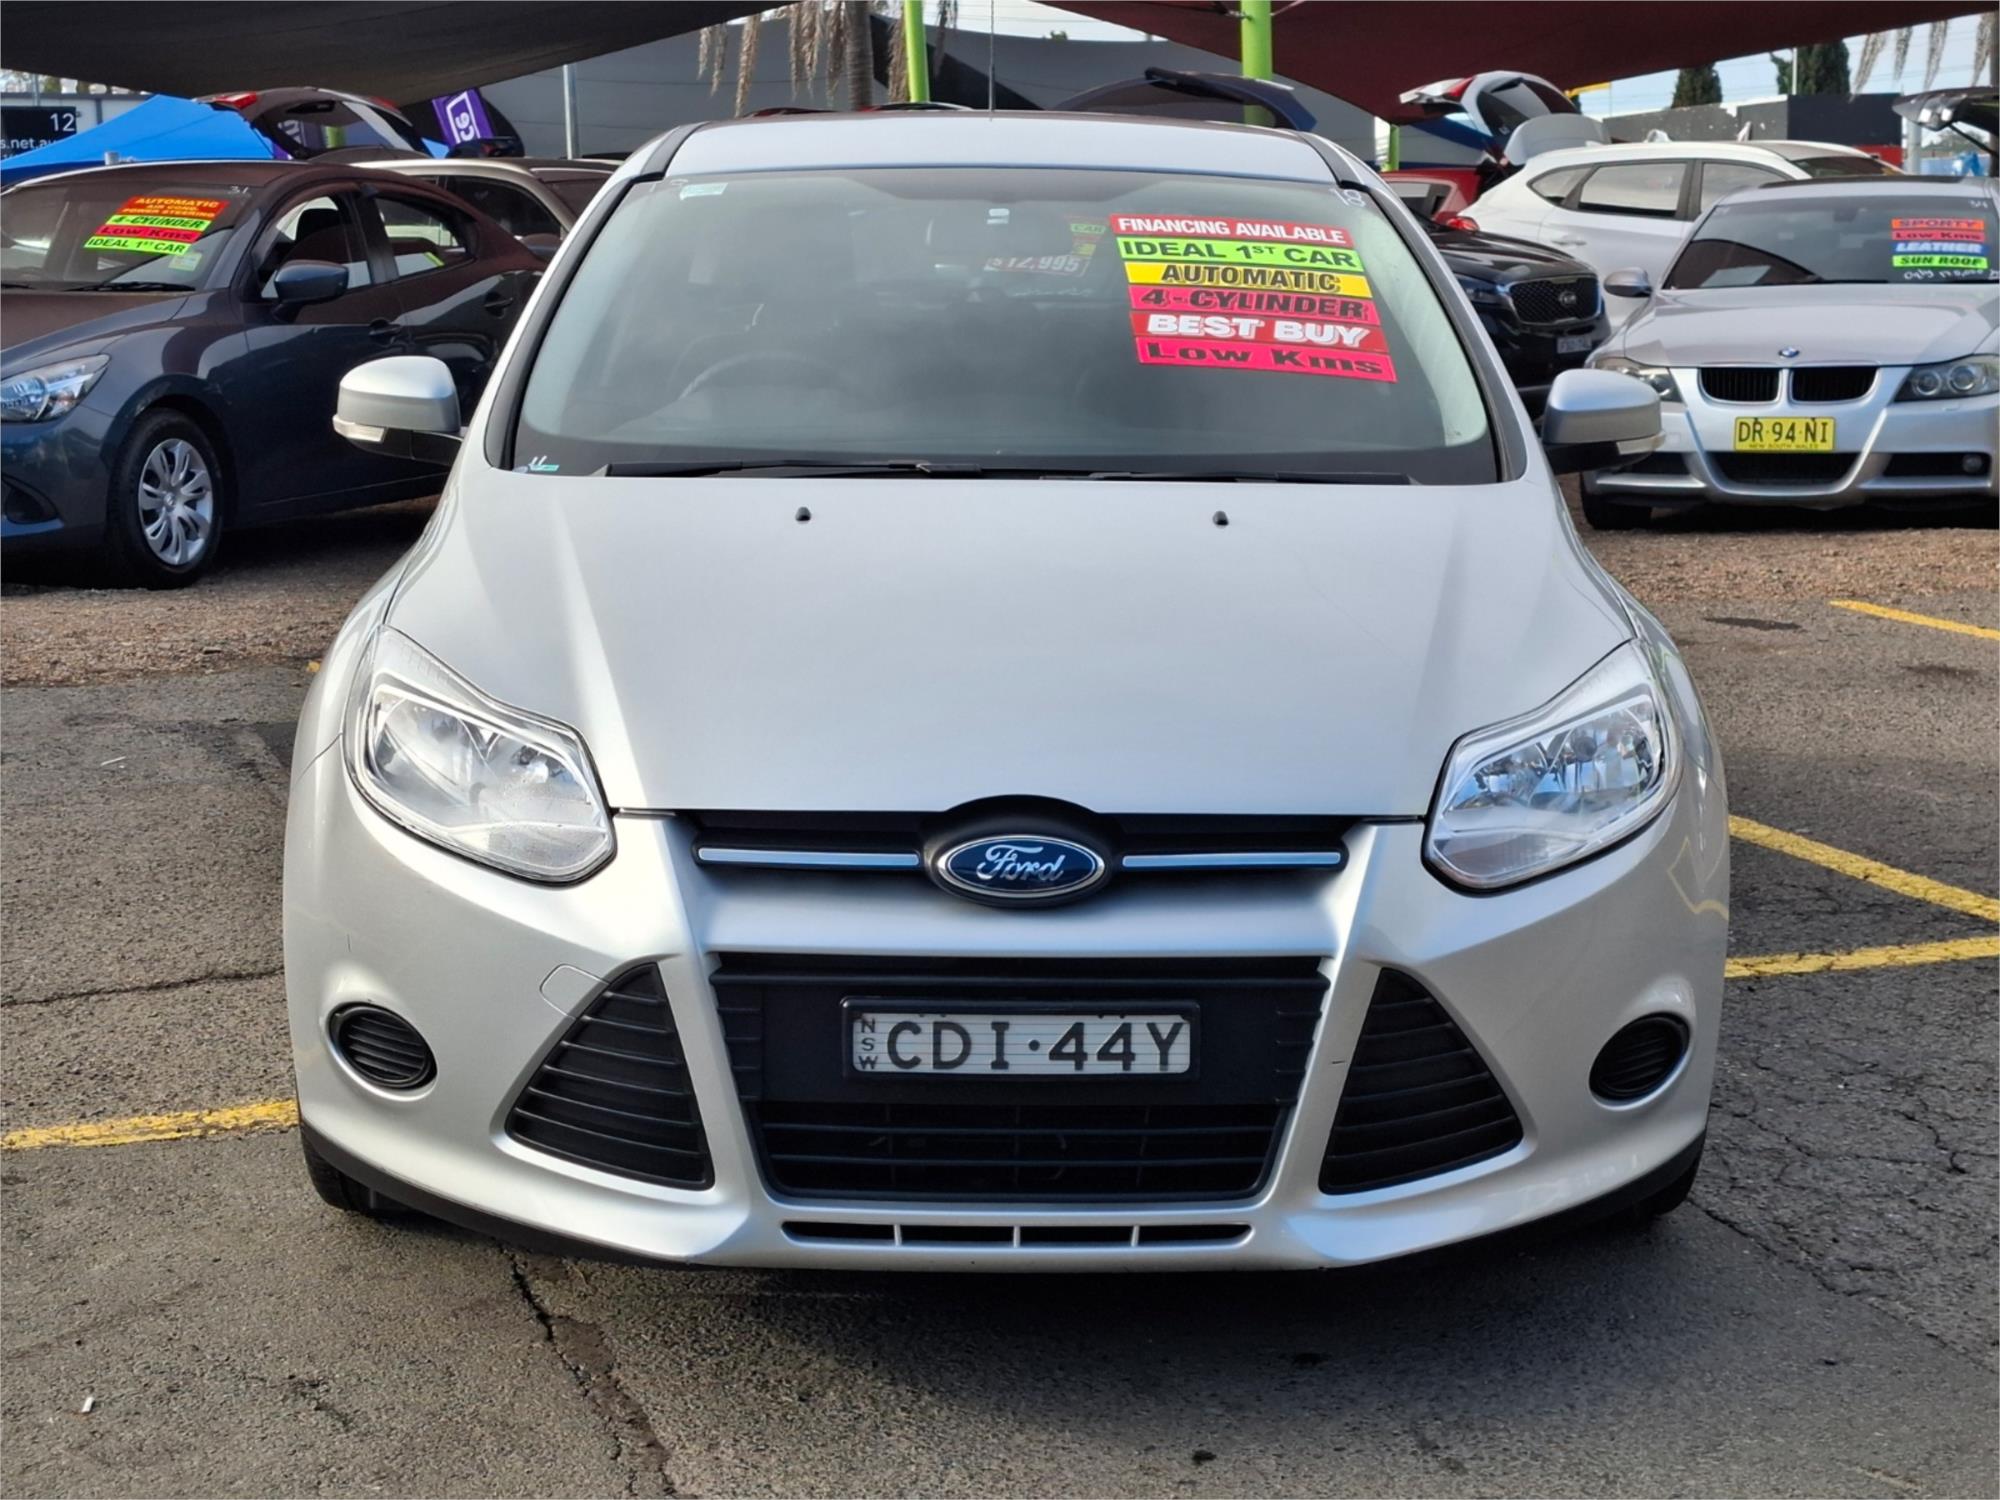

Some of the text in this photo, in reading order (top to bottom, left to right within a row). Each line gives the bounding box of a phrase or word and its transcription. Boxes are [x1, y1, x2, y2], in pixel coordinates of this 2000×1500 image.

[50, 113, 75, 132] 12
[135, 198, 220, 208] AUTOMATIC
[163, 209, 216, 218] STEERING
[1118, 217, 1347, 244] FINANCING AVAILABLE
[88, 237, 129, 248] IDEAL
[154, 243, 185, 253] CAR
[1122, 240, 1356, 267] IDEAL 1ST CAR
[1895, 242, 1982, 253] LEATHER
[1900, 256, 1981, 266] SUN ROOF
[1161, 264, 1341, 292] AUTOMATIC
[1141, 288, 1368, 321] 4-CYLINDER
[1147, 314, 1371, 347] BEST BUY
[1272, 348, 1384, 374] Kms
[976, 844, 1066, 881] Ford
